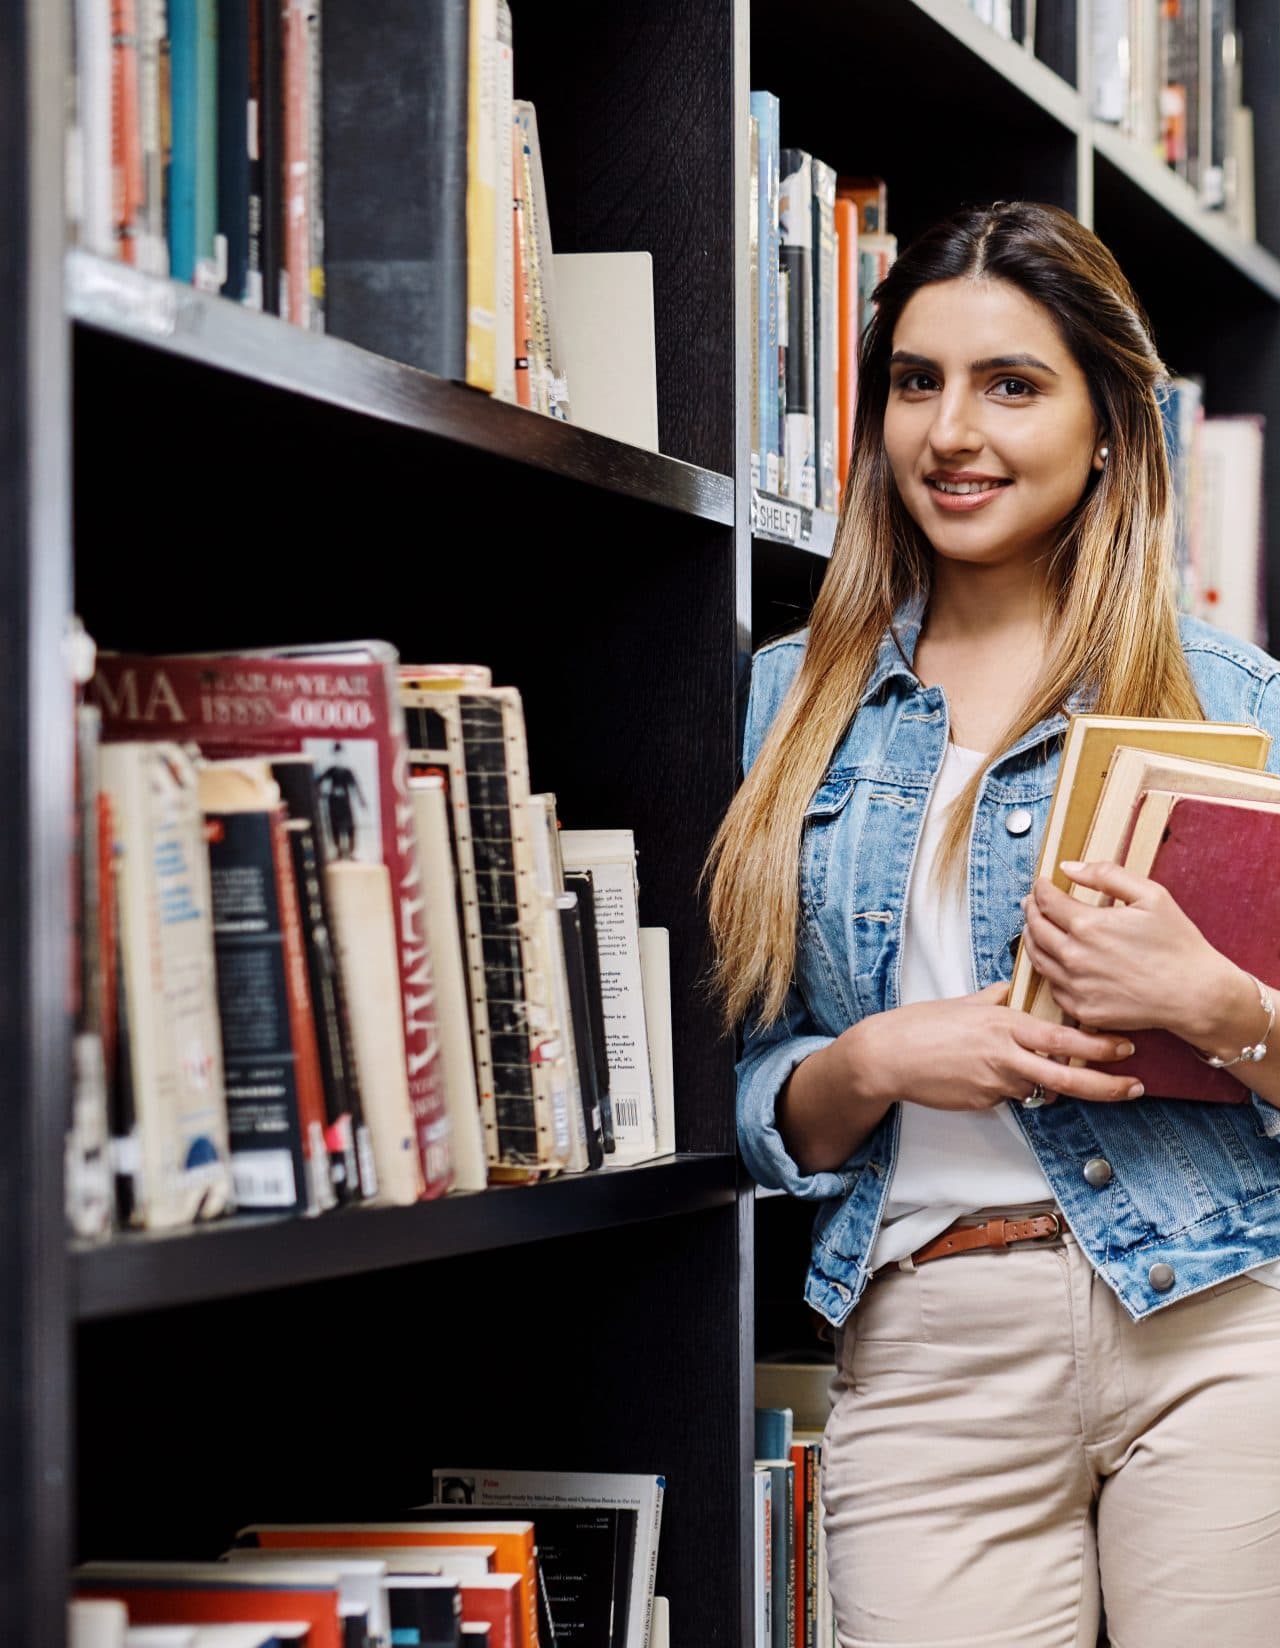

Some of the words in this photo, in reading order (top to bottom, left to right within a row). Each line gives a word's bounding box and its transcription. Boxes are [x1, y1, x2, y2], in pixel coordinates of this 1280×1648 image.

[760, 505, 790, 532] SHELF
[792, 514, 798, 533] 7
[649, 1550, 657, 1571] WHAT
[647, 1574, 655, 1595] GOES
[643, 1598, 653, 1630] AROUND
